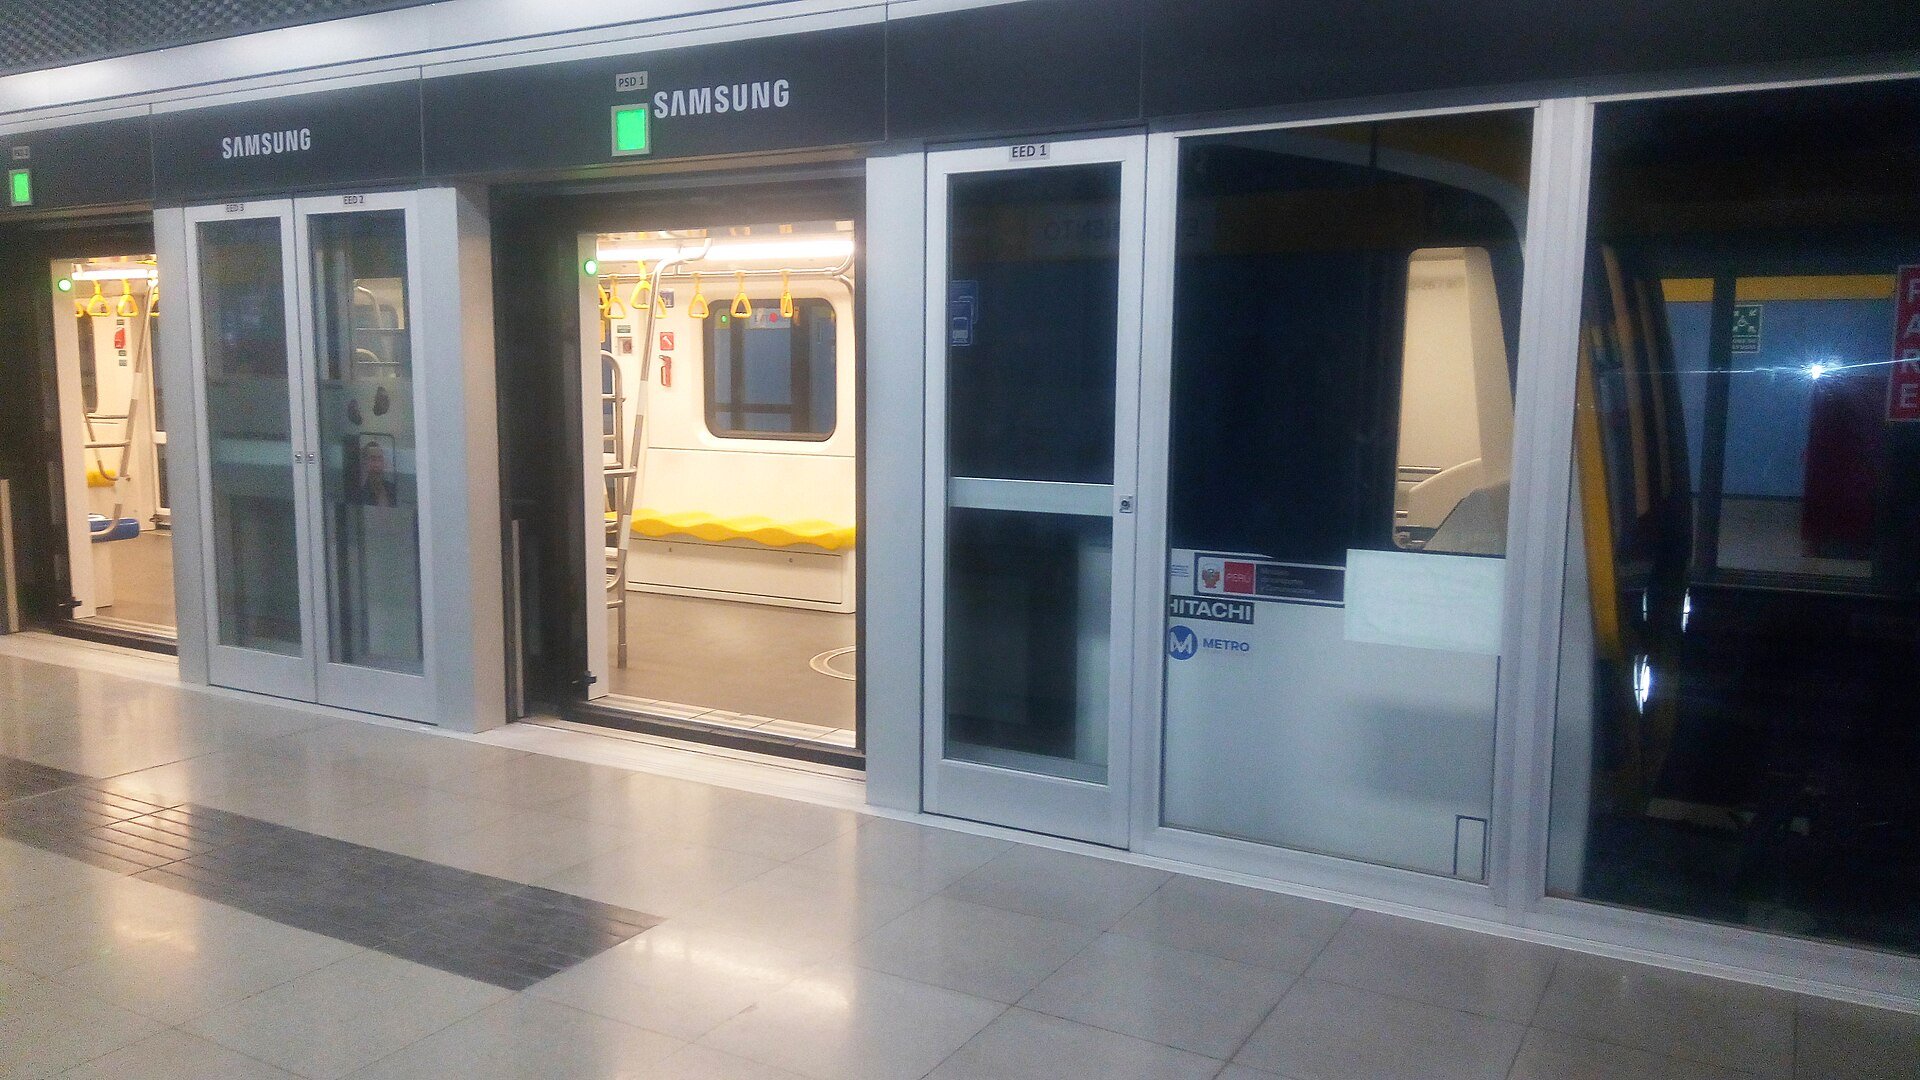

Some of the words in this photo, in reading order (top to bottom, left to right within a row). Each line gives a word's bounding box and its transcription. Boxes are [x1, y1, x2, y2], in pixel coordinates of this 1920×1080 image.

[618, 76, 637, 88] PSD
[639, 75, 645, 86] 1
[654, 79, 789, 119] SAMSUNG
[222, 128, 311, 159] SAMSUNG
[1012, 146, 1035, 157] EED
[1040, 145, 1046, 155] 1
[343, 195, 358, 205] EED
[359, 195, 364, 204] 2
[1202, 639, 1250, 651] METRO
